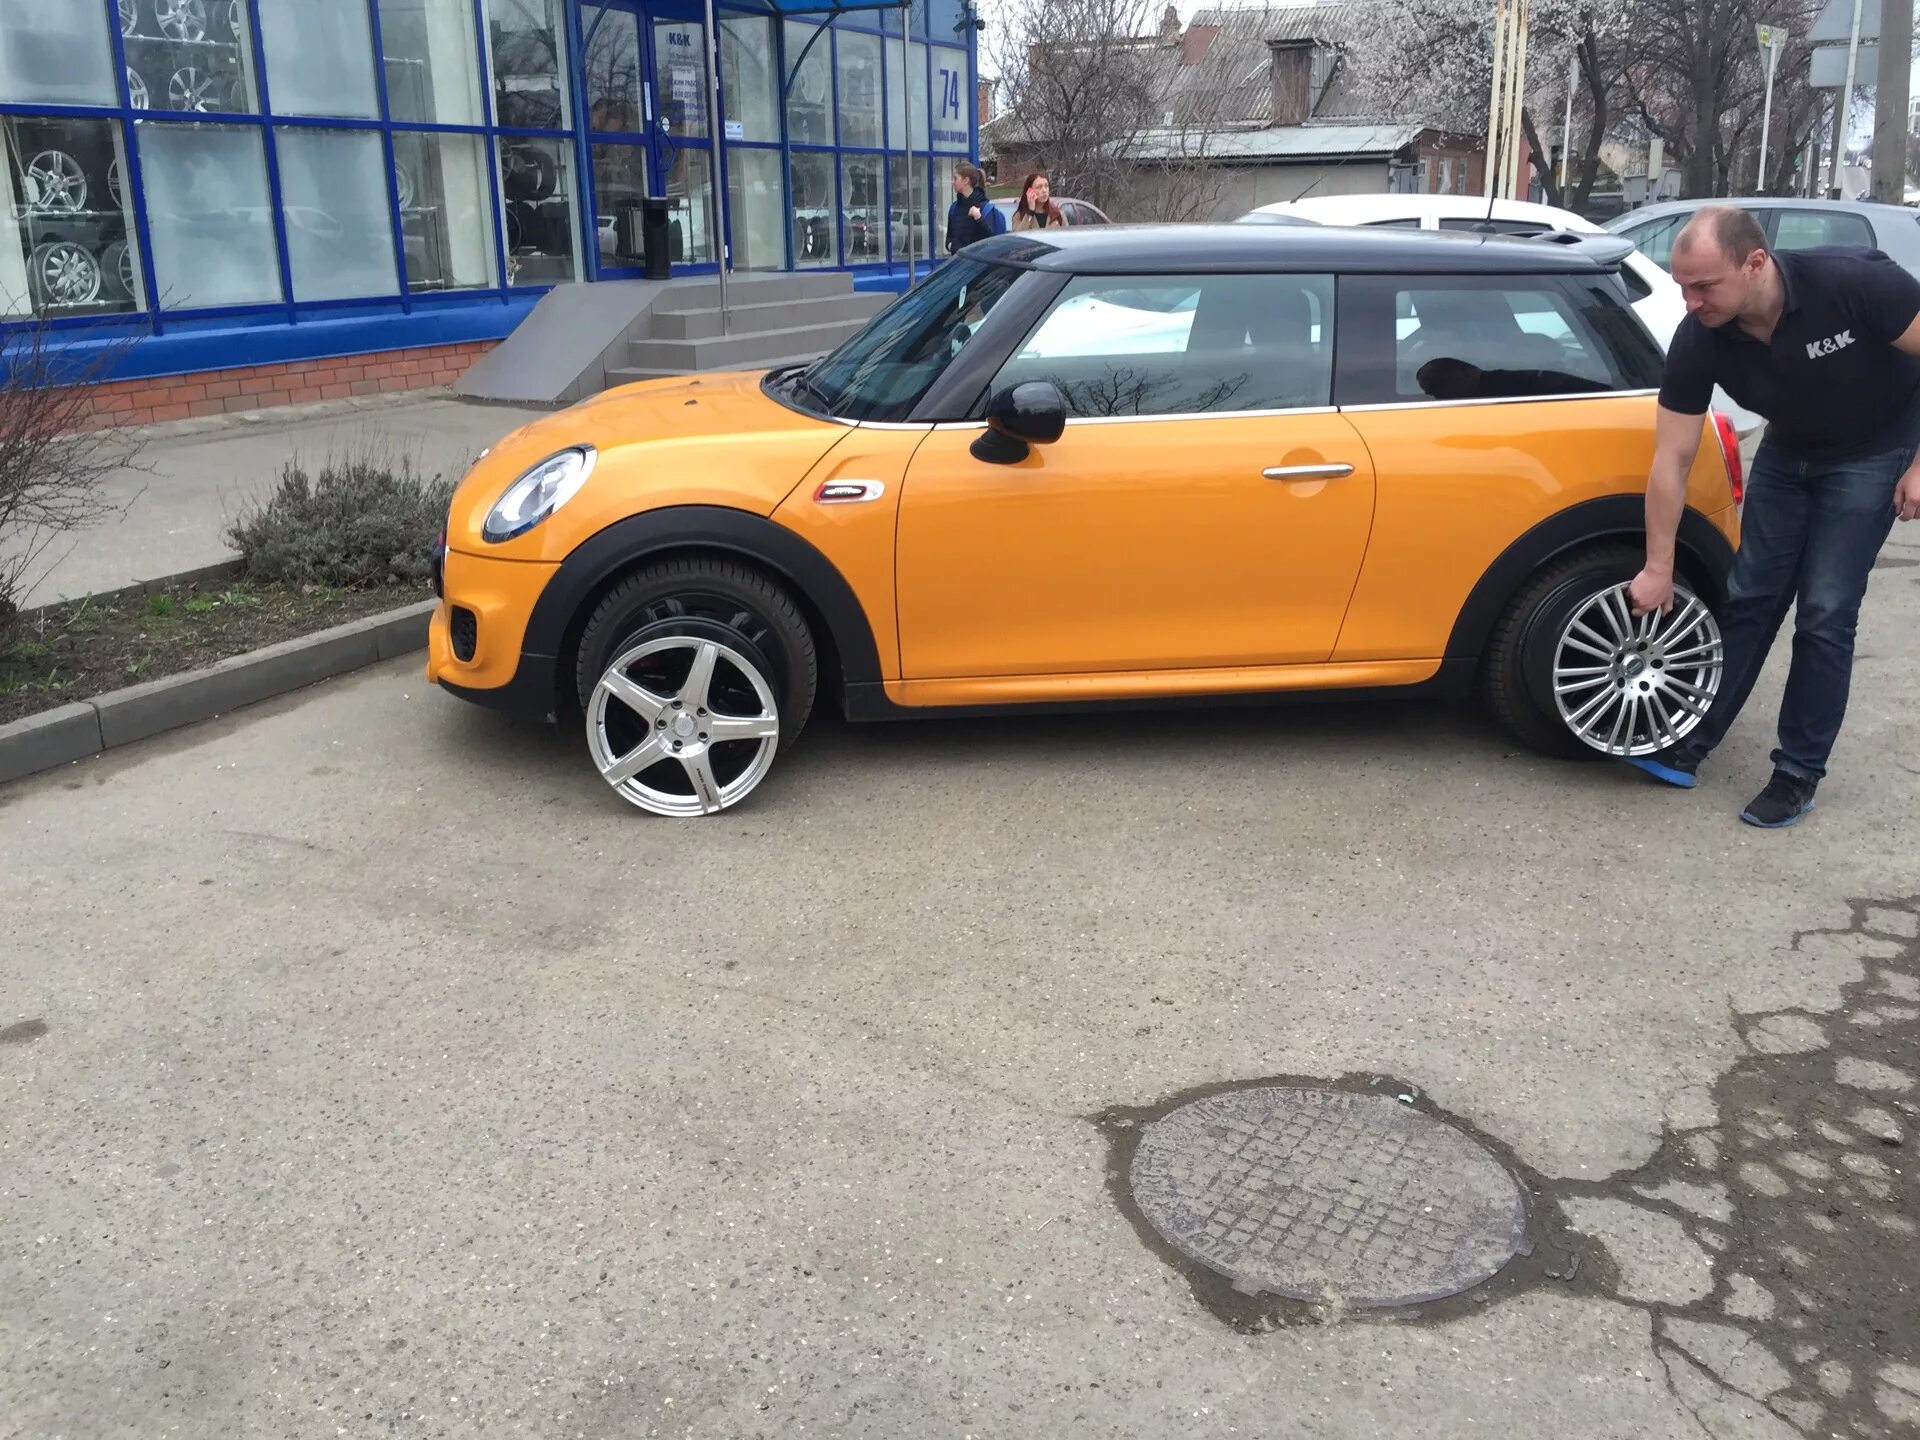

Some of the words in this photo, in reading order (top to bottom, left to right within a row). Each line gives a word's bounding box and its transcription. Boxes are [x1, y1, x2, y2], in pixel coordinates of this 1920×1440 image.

[668, 31, 691, 46] K&K
[939, 68, 959, 120] 74
[1806, 329, 1856, 360] K&K
